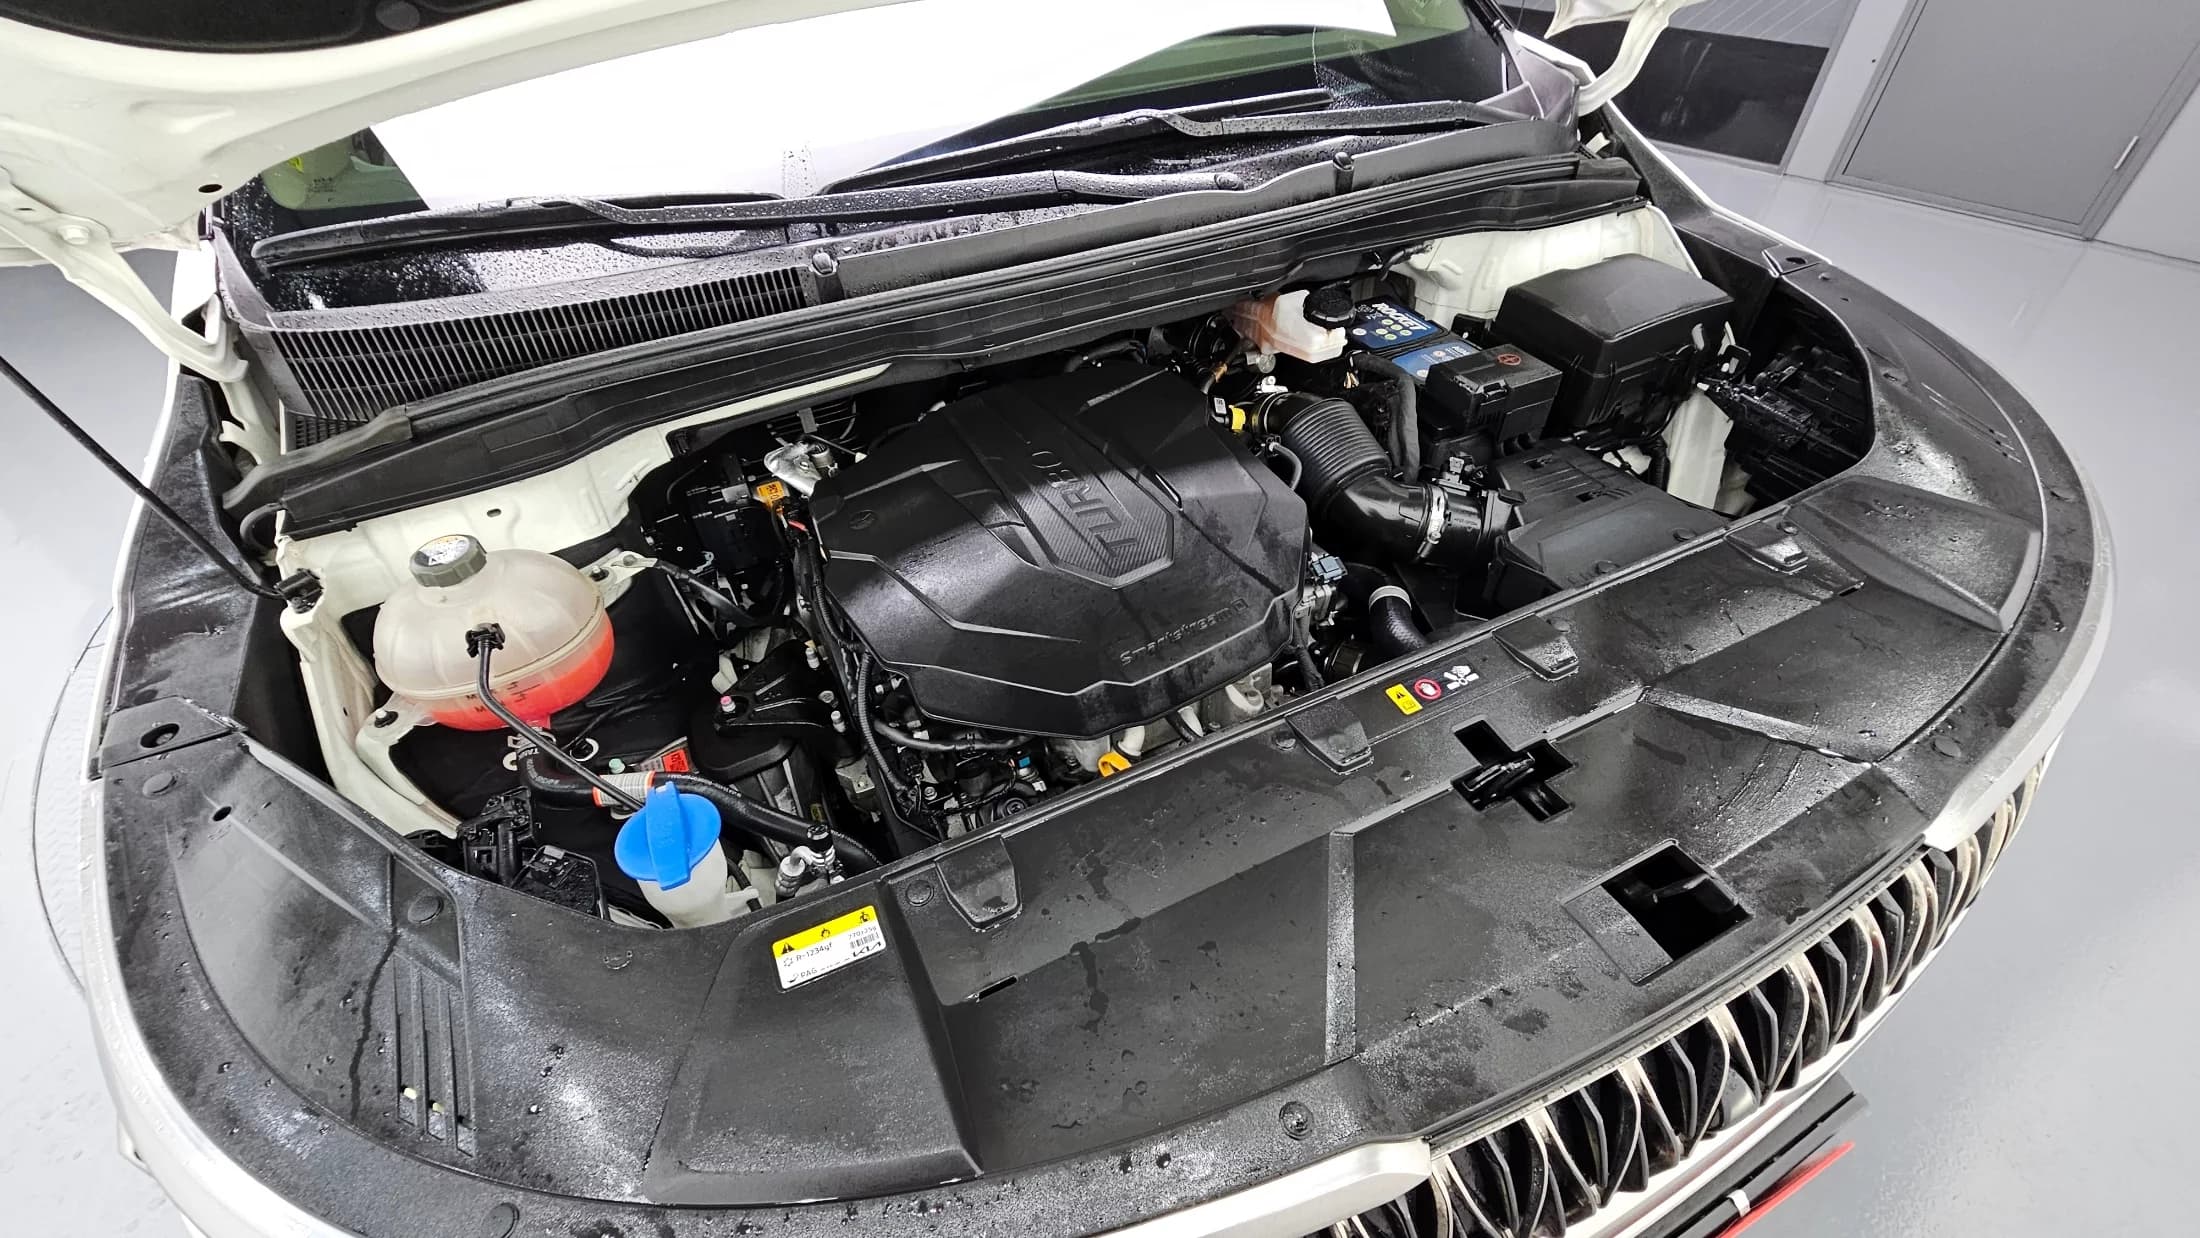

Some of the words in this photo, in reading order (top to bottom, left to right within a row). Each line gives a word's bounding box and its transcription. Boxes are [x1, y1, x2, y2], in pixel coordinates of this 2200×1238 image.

[1372, 303, 1427, 330] ROCKET
[1031, 450, 1138, 557] TURBO
[1120, 607, 1232, 666] Smartstream
[853, 941, 881, 957] KIA
